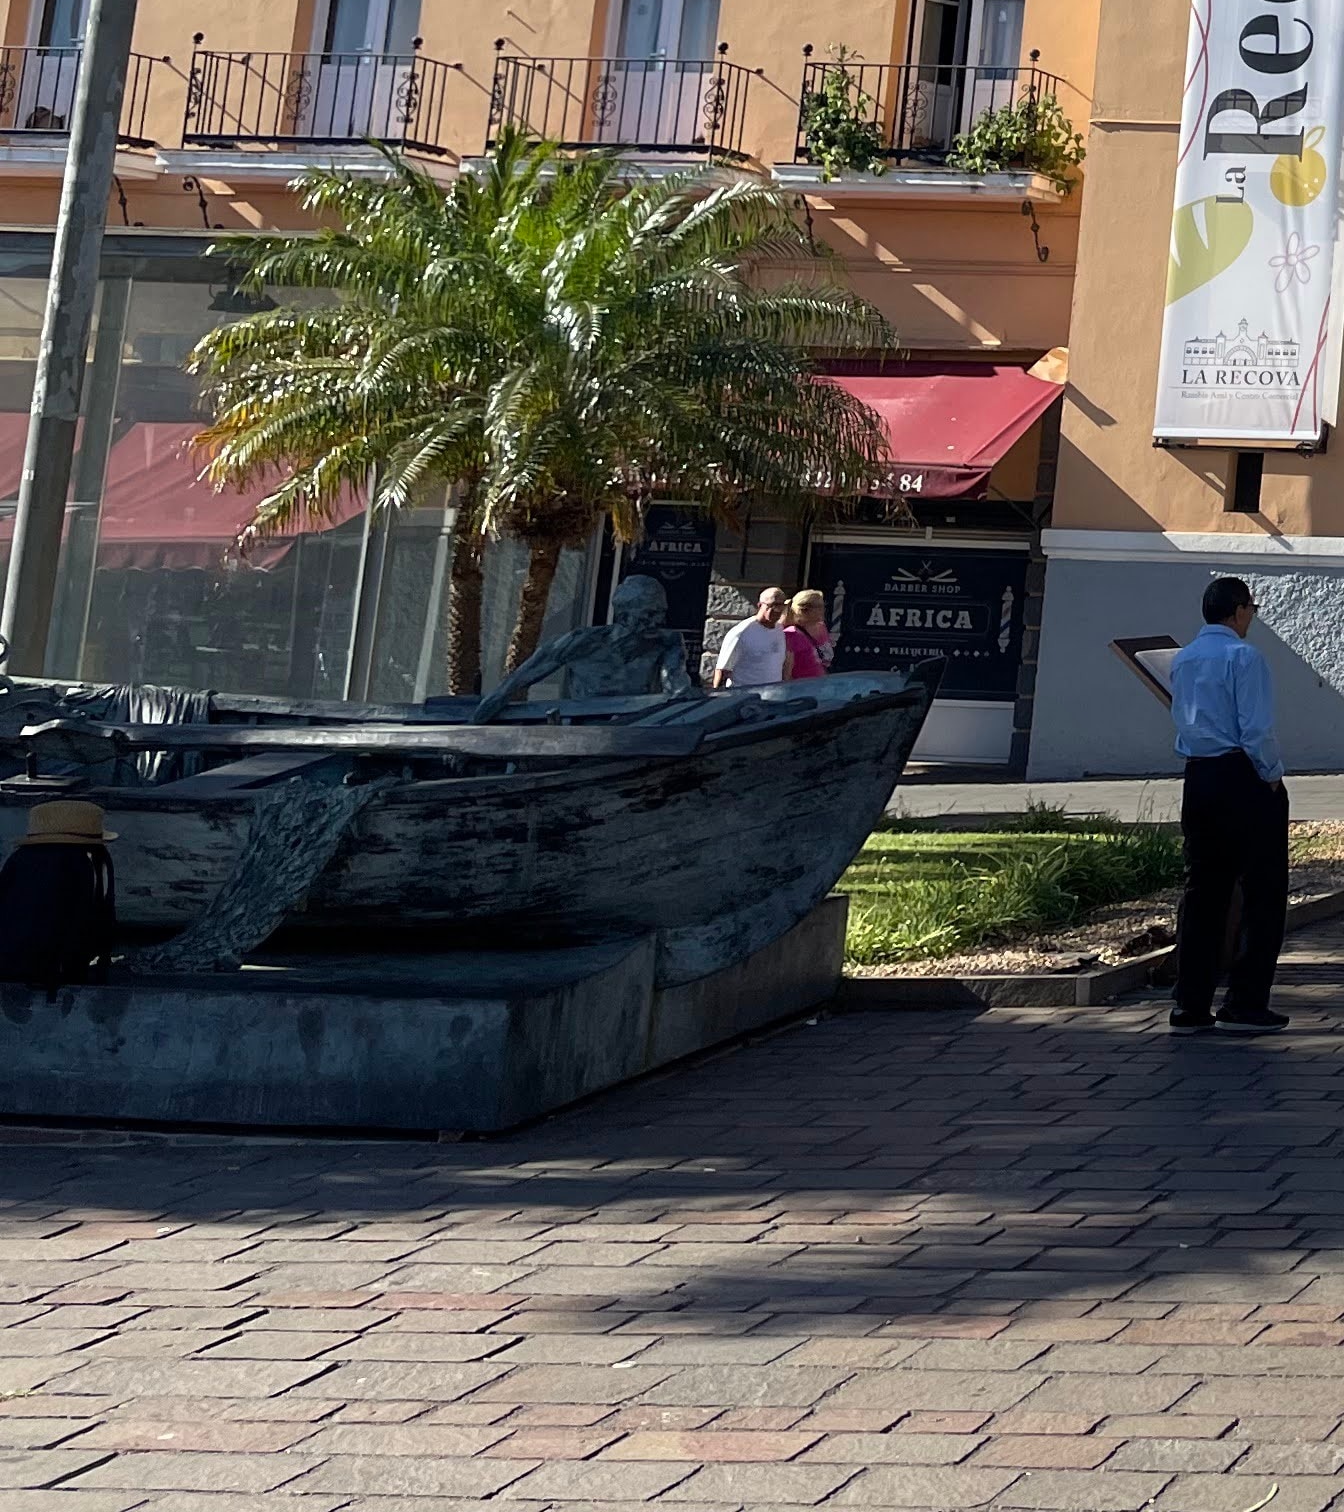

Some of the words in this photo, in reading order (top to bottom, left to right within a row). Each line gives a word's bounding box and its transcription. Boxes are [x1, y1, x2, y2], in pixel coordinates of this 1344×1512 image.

[1215, 166, 1246, 204] La
[1181, 369, 1208, 385] LA
[1215, 370, 1301, 386] RECOVA
[884, 583, 928, 594] BARBER
[931, 584, 961, 594] SHOP
[866, 602, 973, 630] ÁFRICA
